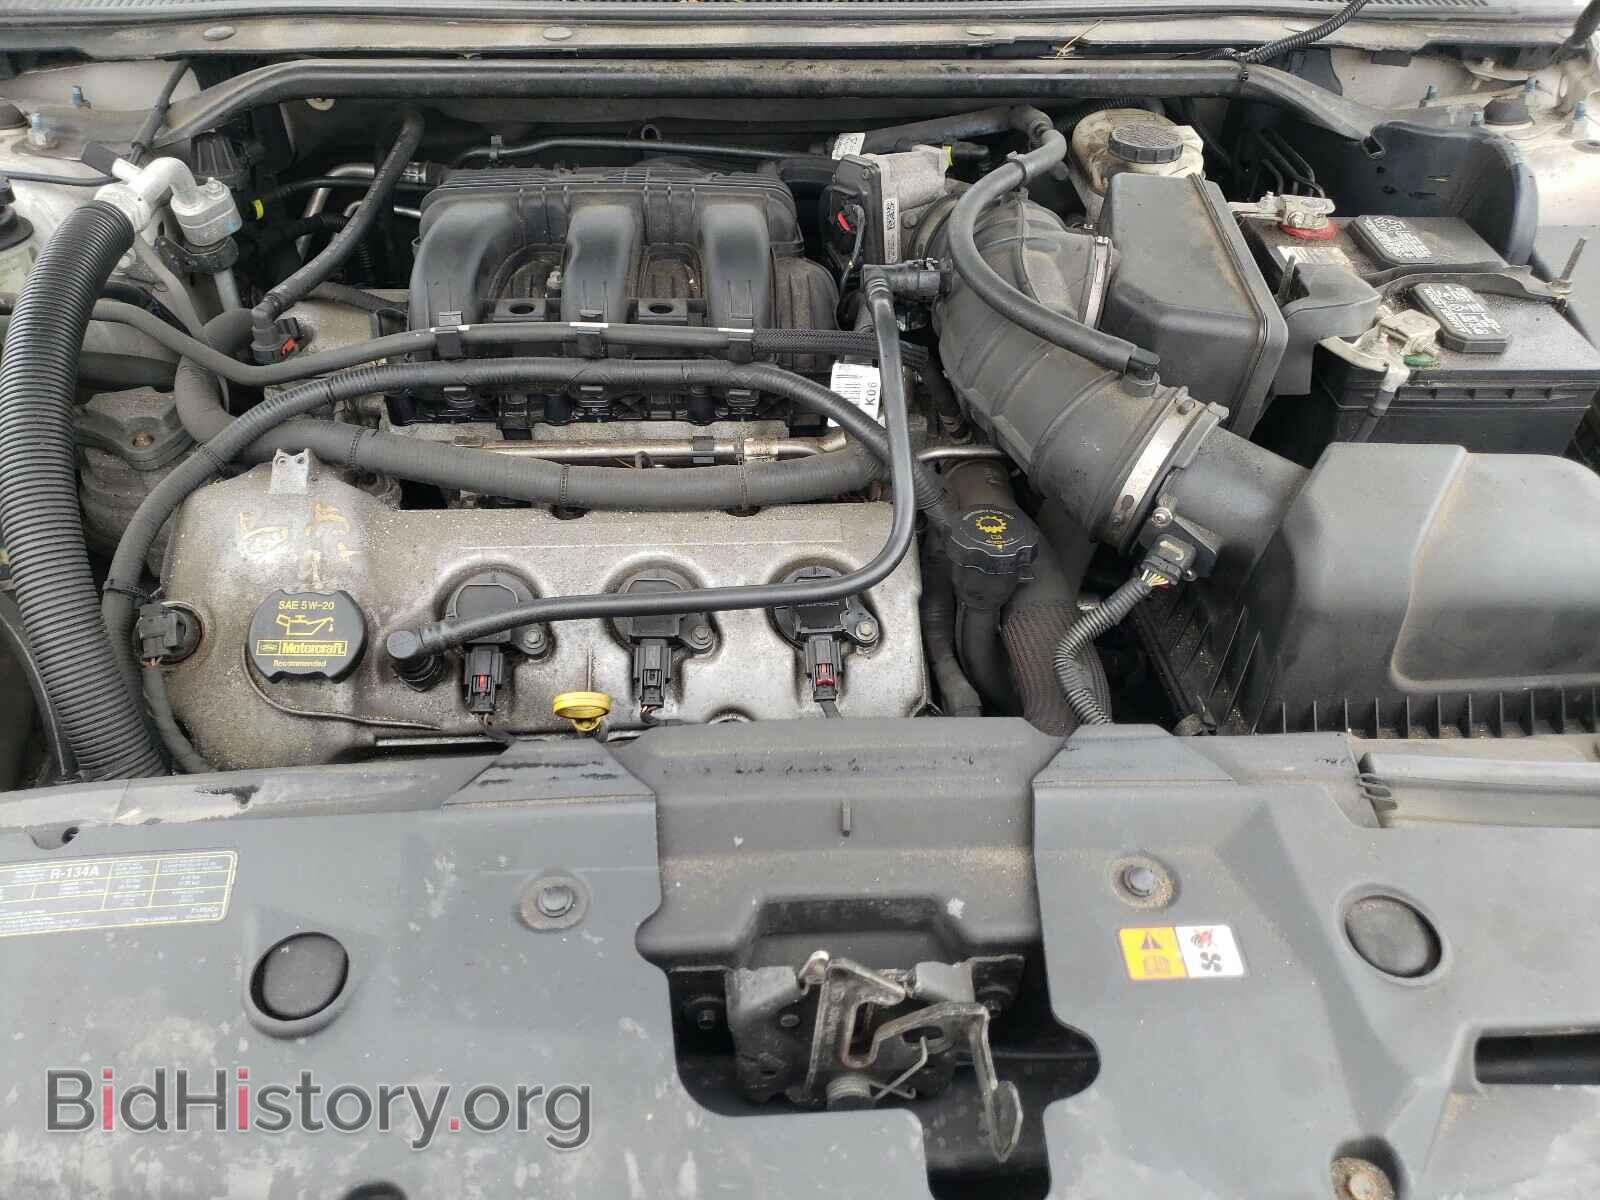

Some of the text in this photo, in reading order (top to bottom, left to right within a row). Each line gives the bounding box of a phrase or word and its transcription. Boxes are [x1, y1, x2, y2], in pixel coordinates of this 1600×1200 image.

[864, 382, 878, 406] K06
[278, 600, 335, 610] SAE 5W-20
[273, 659, 327, 668] Recommended
[50, 864, 100, 880] R-134A
